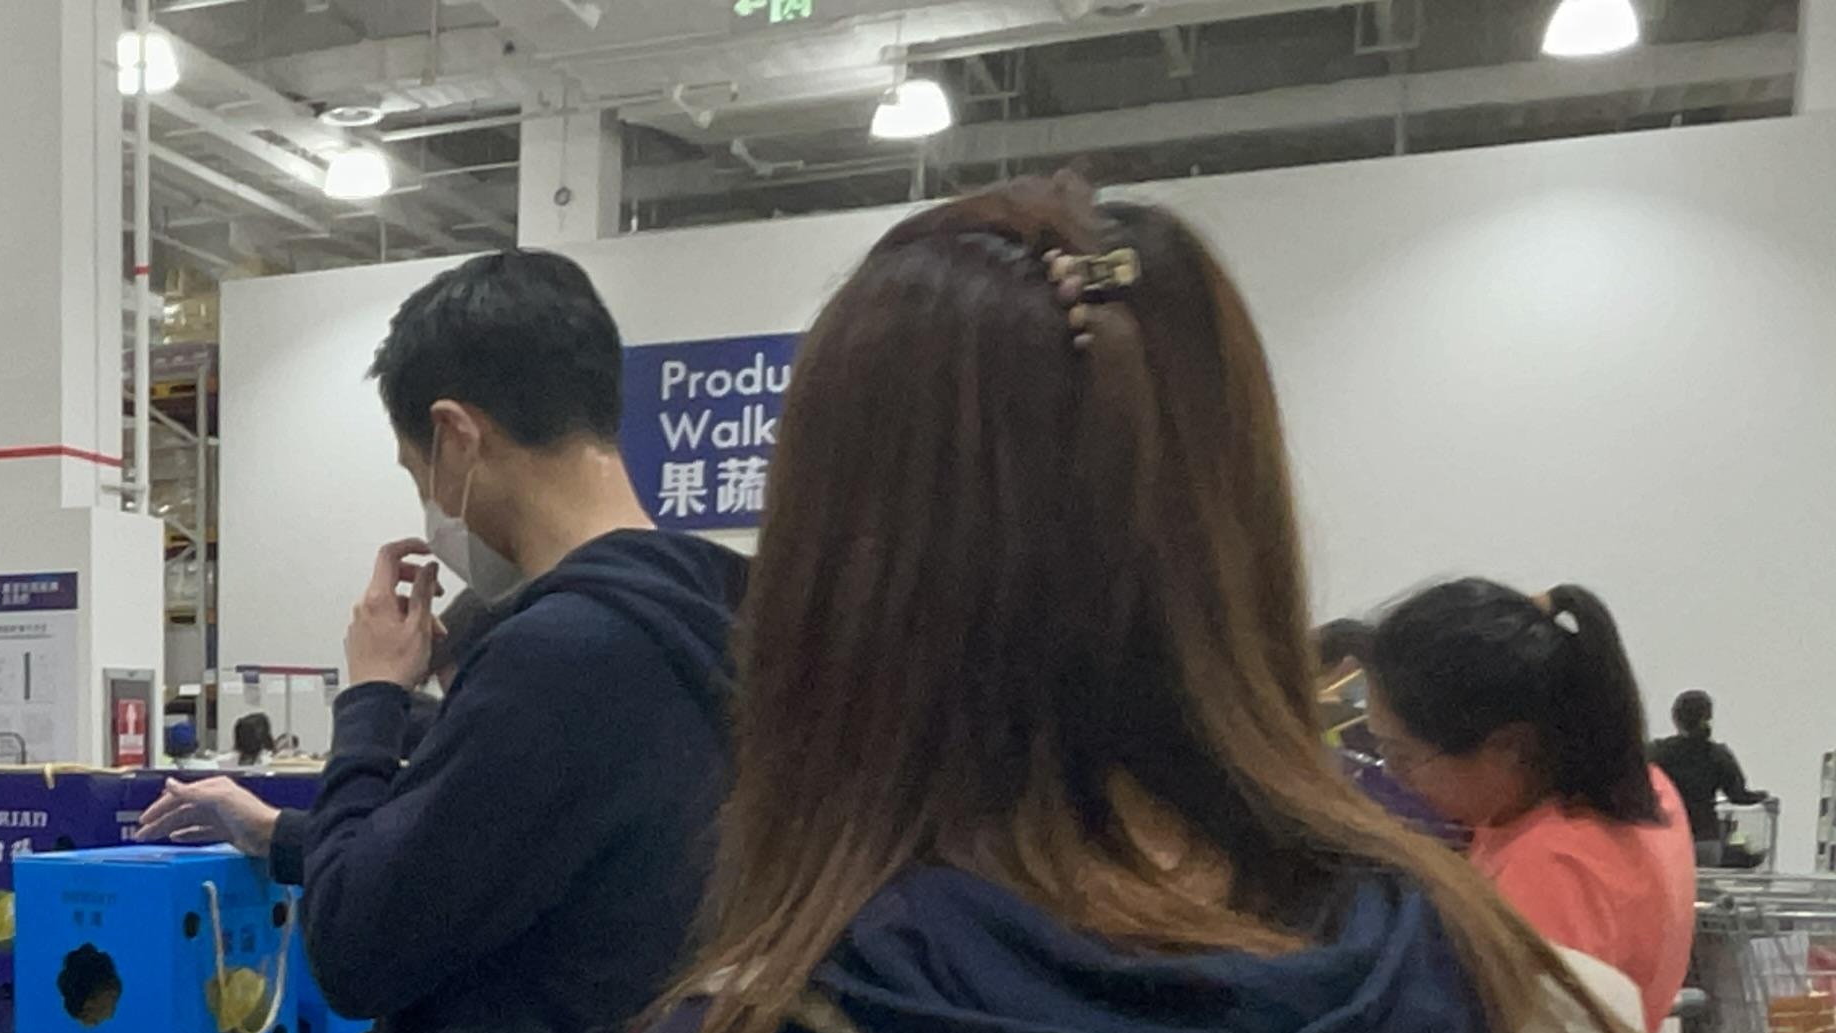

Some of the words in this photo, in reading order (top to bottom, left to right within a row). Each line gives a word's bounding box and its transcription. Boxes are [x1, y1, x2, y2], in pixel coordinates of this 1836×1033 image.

[661, 352, 792, 401] Produ
[659, 404, 778, 451] Walk
[658, 456, 769, 517] 果蔬
